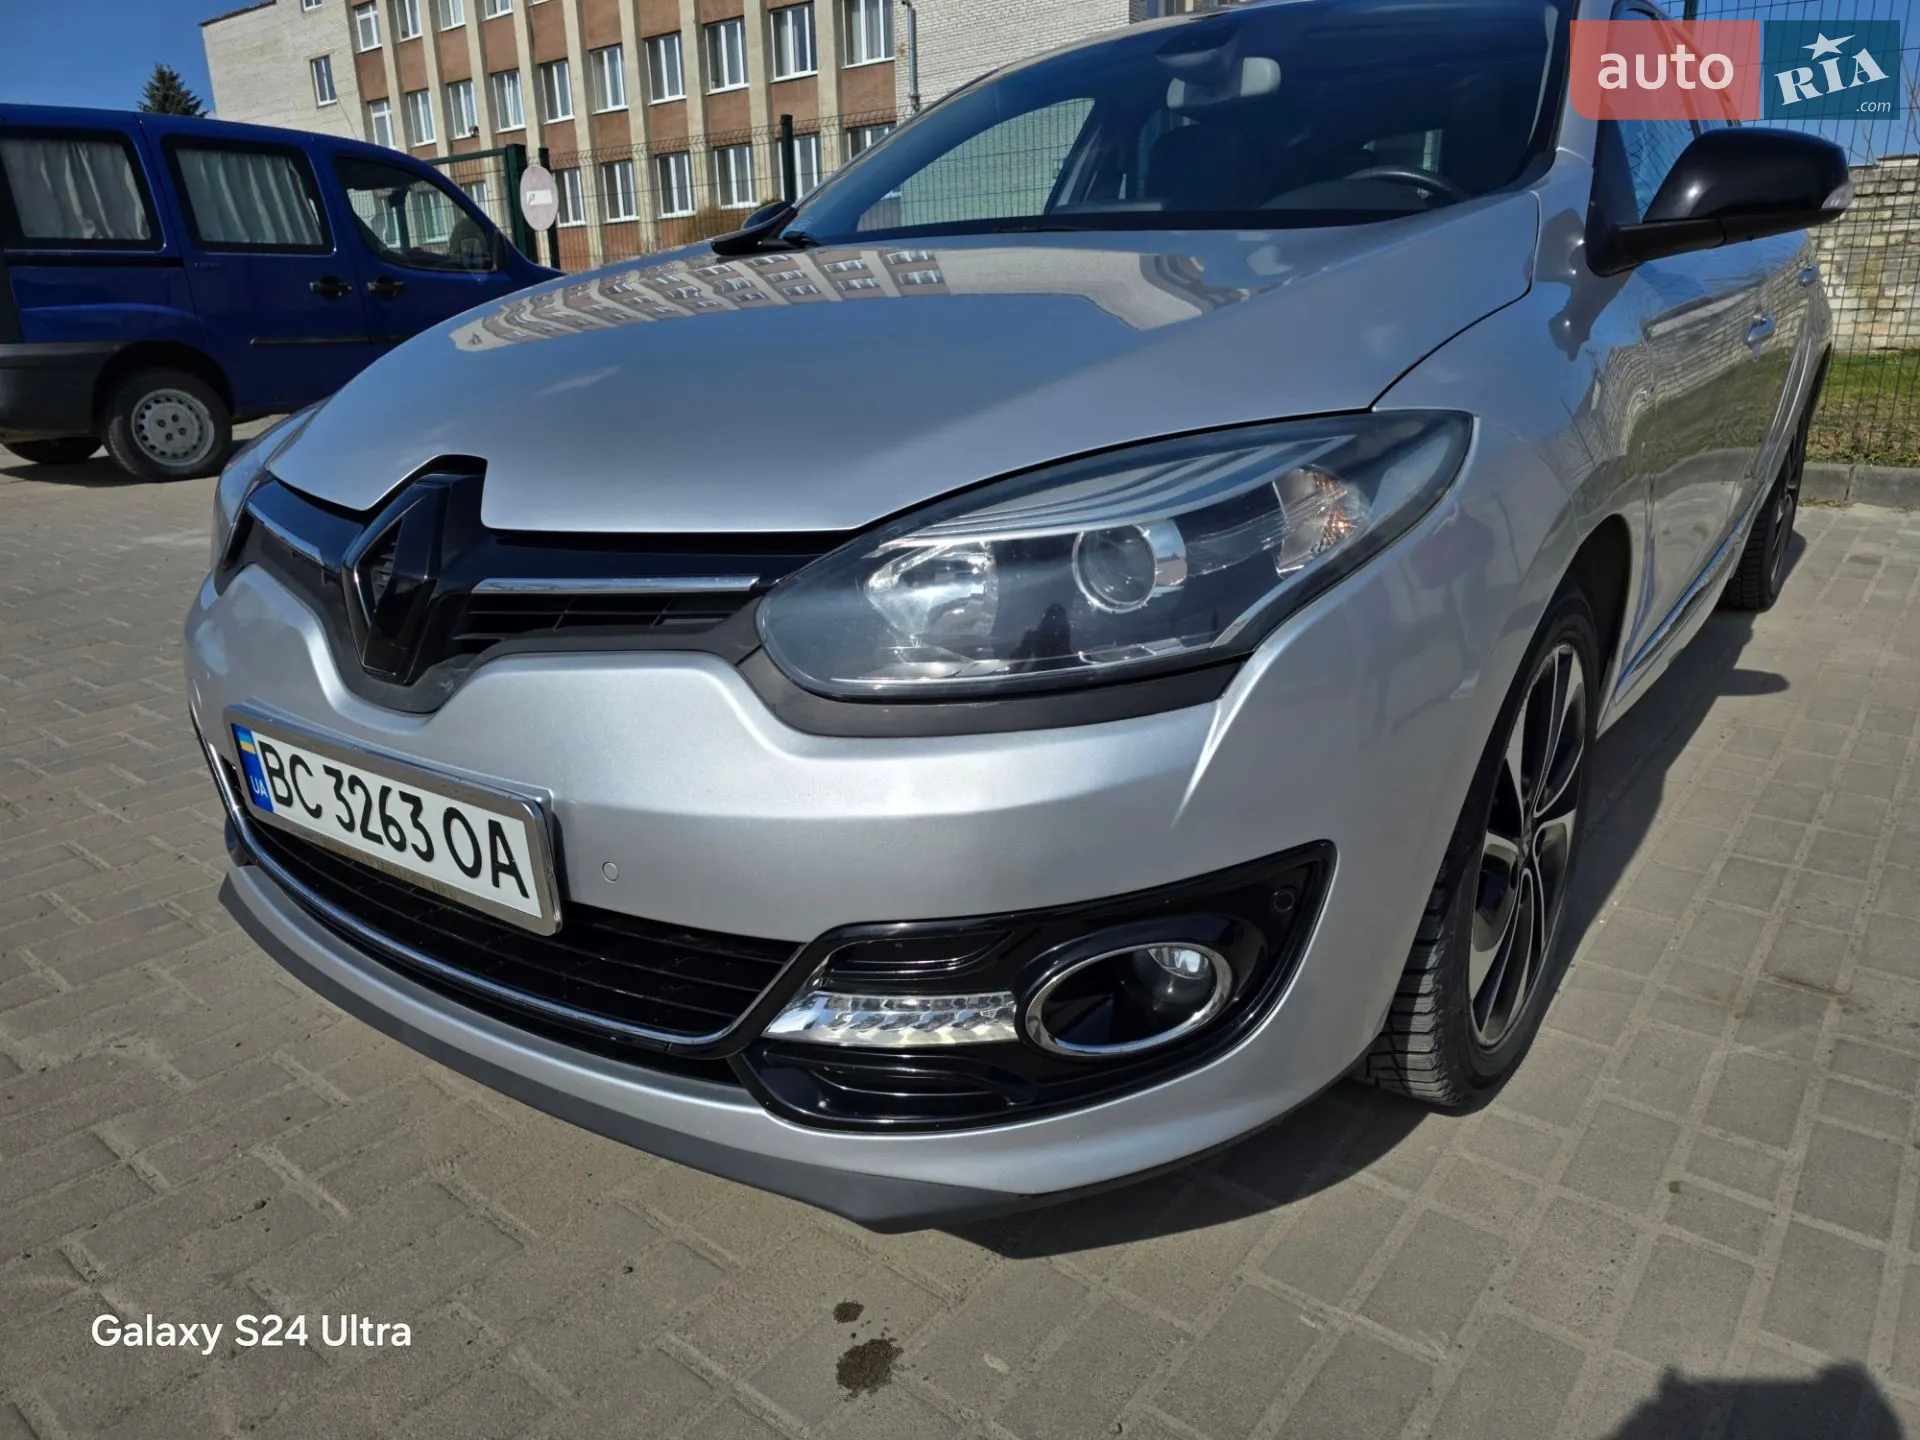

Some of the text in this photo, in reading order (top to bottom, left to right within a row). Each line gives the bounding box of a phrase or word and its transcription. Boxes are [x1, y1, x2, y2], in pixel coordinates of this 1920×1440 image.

[251, 775, 269, 800] UA
[258, 740, 530, 899] BC 3263 OA
